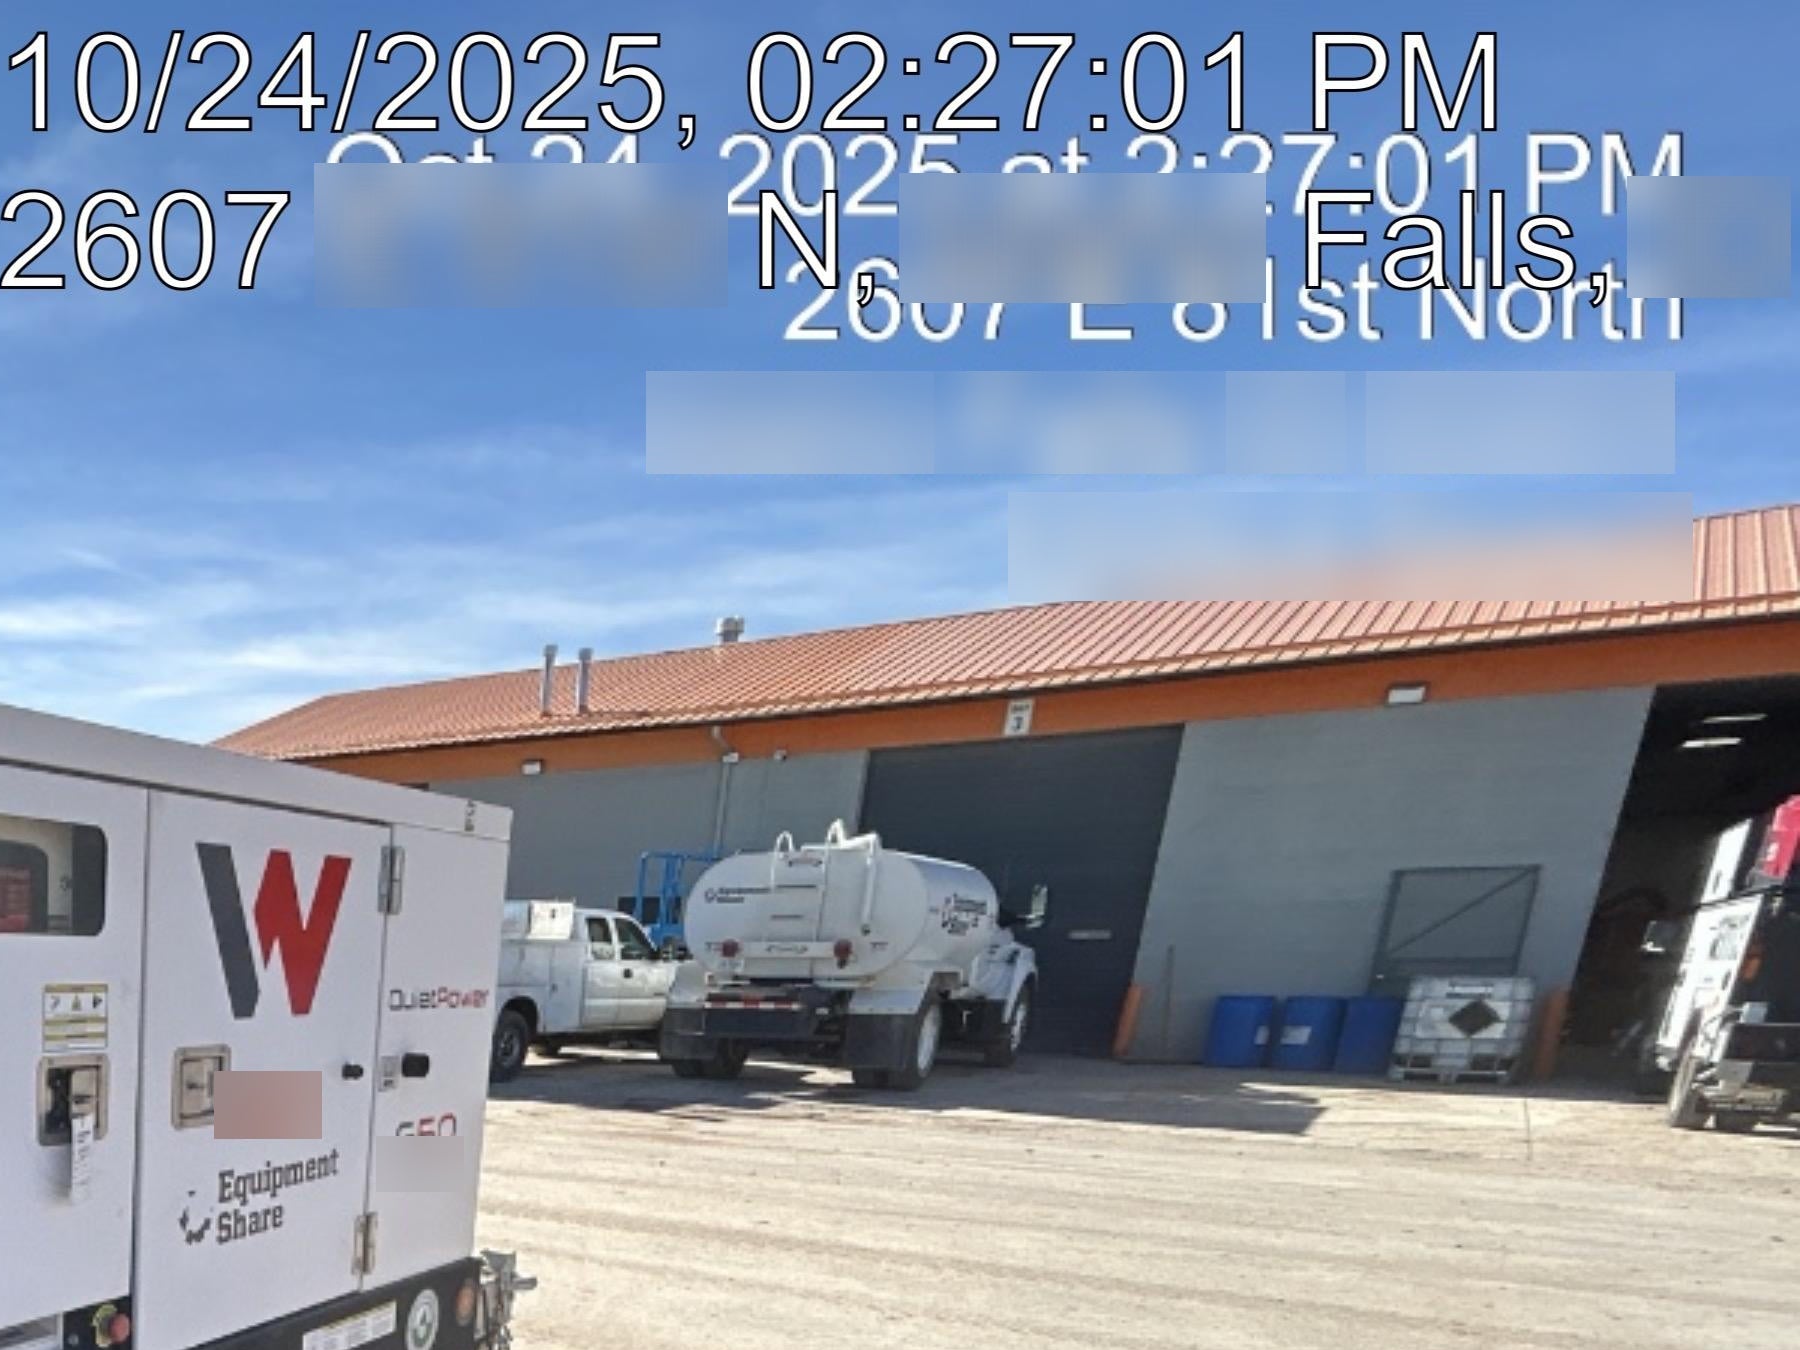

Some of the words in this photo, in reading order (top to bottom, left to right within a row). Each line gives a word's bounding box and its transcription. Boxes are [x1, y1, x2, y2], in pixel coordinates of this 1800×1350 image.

[195, 841, 354, 1020] W
[217, 1147, 340, 1207] Equipment
[215, 1204, 285, 1245] Share
